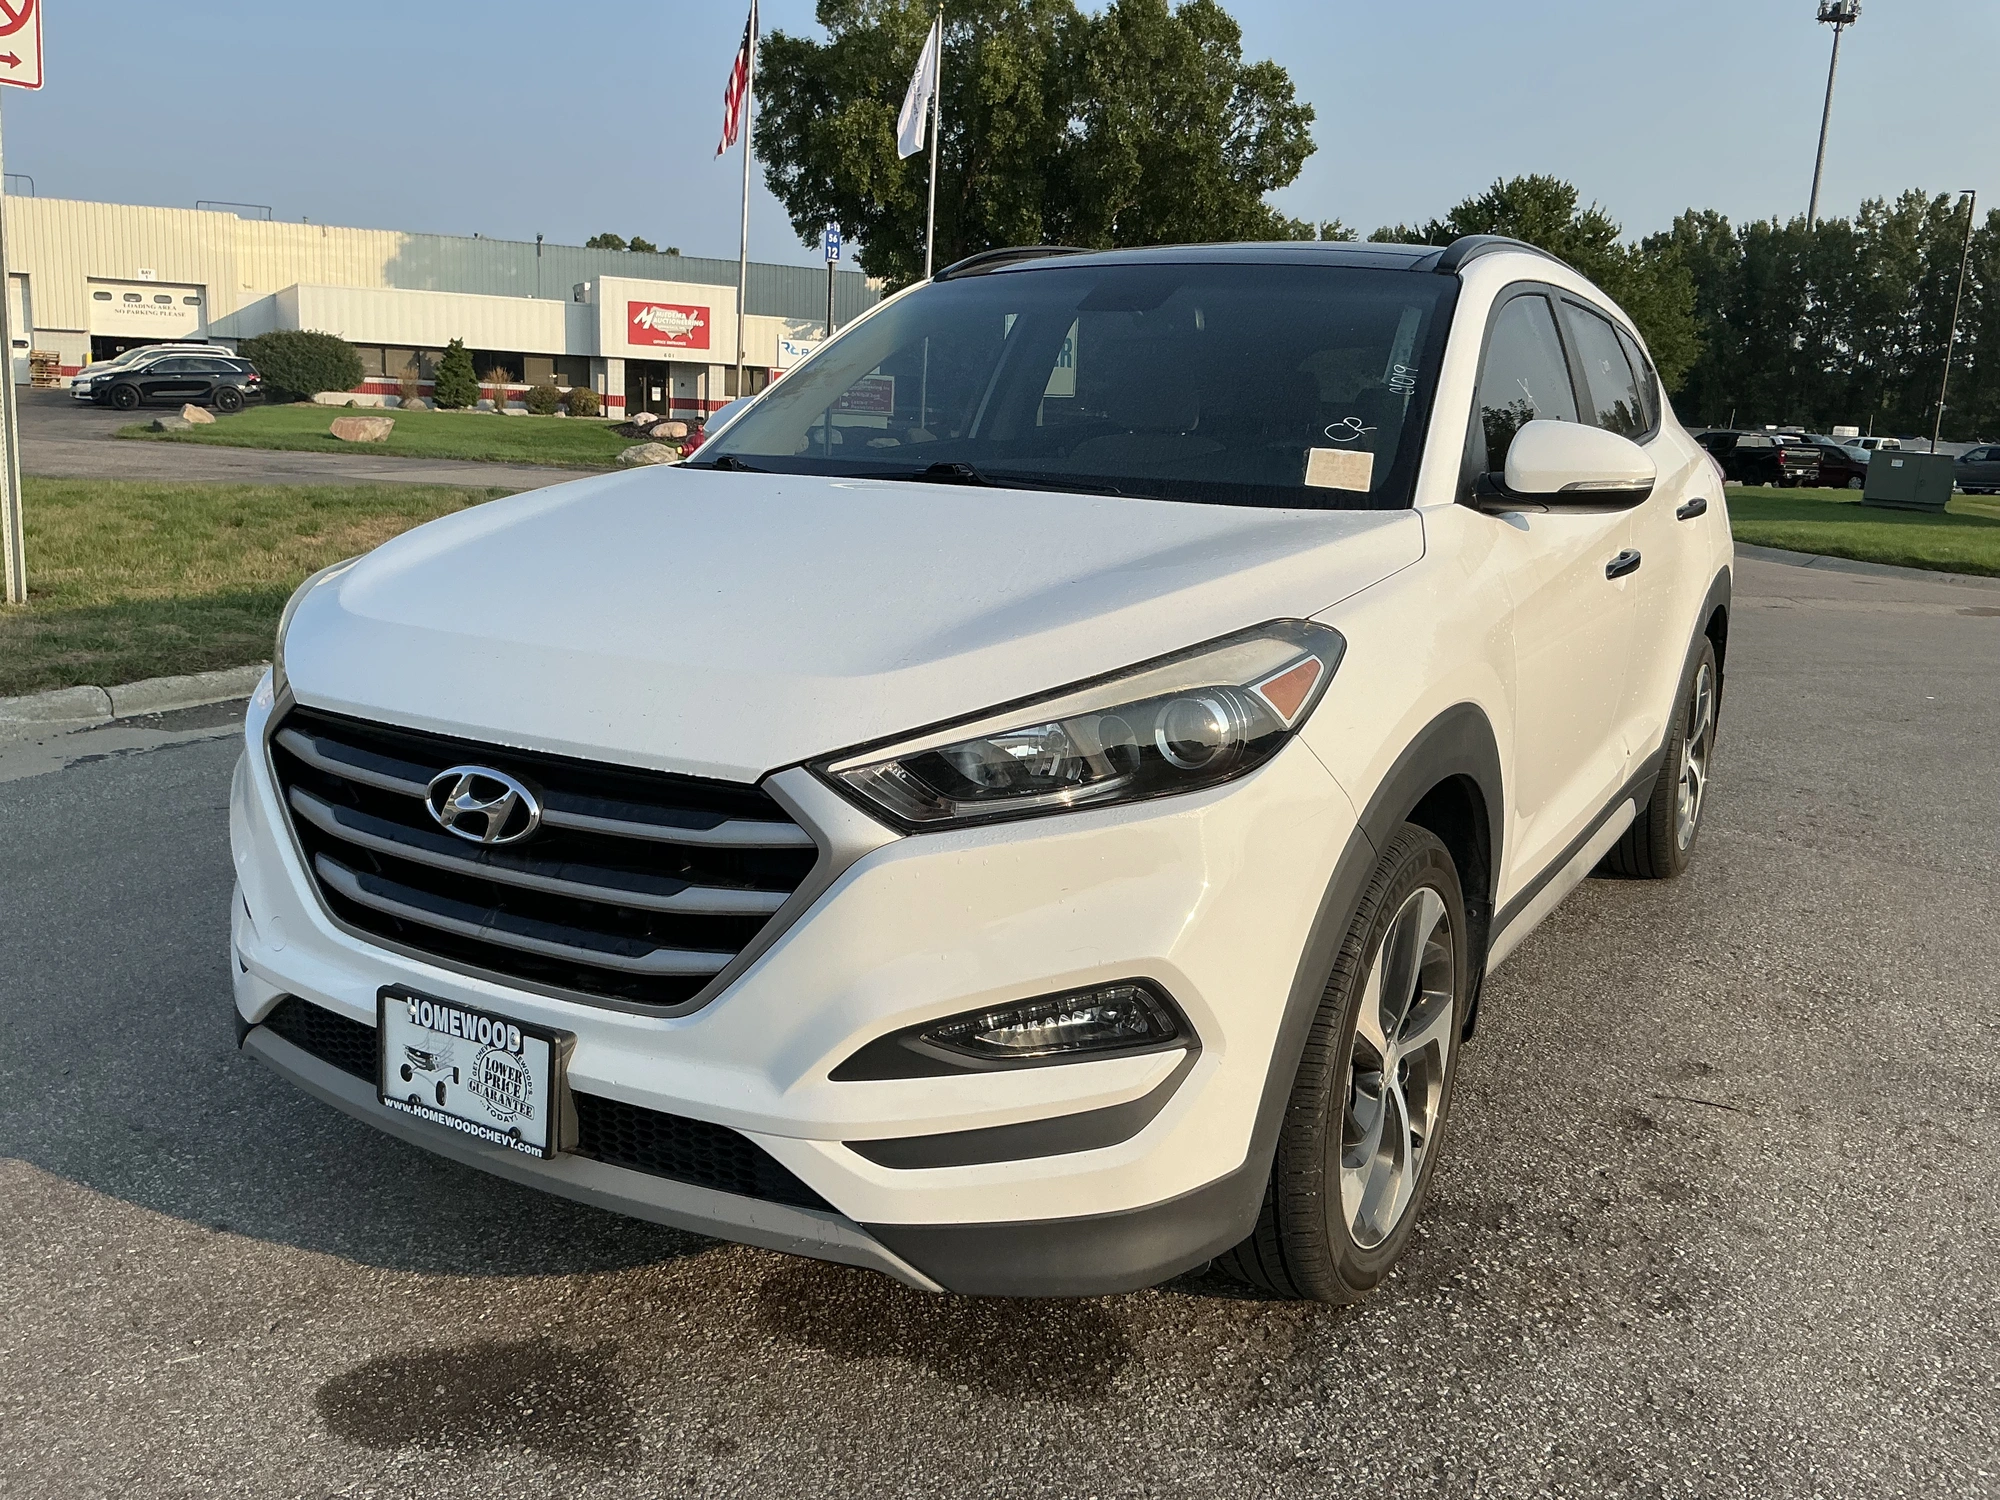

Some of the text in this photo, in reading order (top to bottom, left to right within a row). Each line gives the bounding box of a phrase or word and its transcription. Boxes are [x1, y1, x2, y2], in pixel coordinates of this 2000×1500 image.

[827, 246, 838, 258] 12
[828, 233, 838, 243] 56
[653, 317, 705, 327] AUCTIONEERING
[655, 311, 686, 319] MIEDEMA
[406, 996, 521, 1053] HOMEWOOD
[484, 1070, 521, 1099] PRICE
[485, 1056, 523, 1085] LOWER
[469, 1080, 533, 1118] GUARANTEE
[383, 1097, 543, 1158] www.HOMEWOODCHEVY.com
